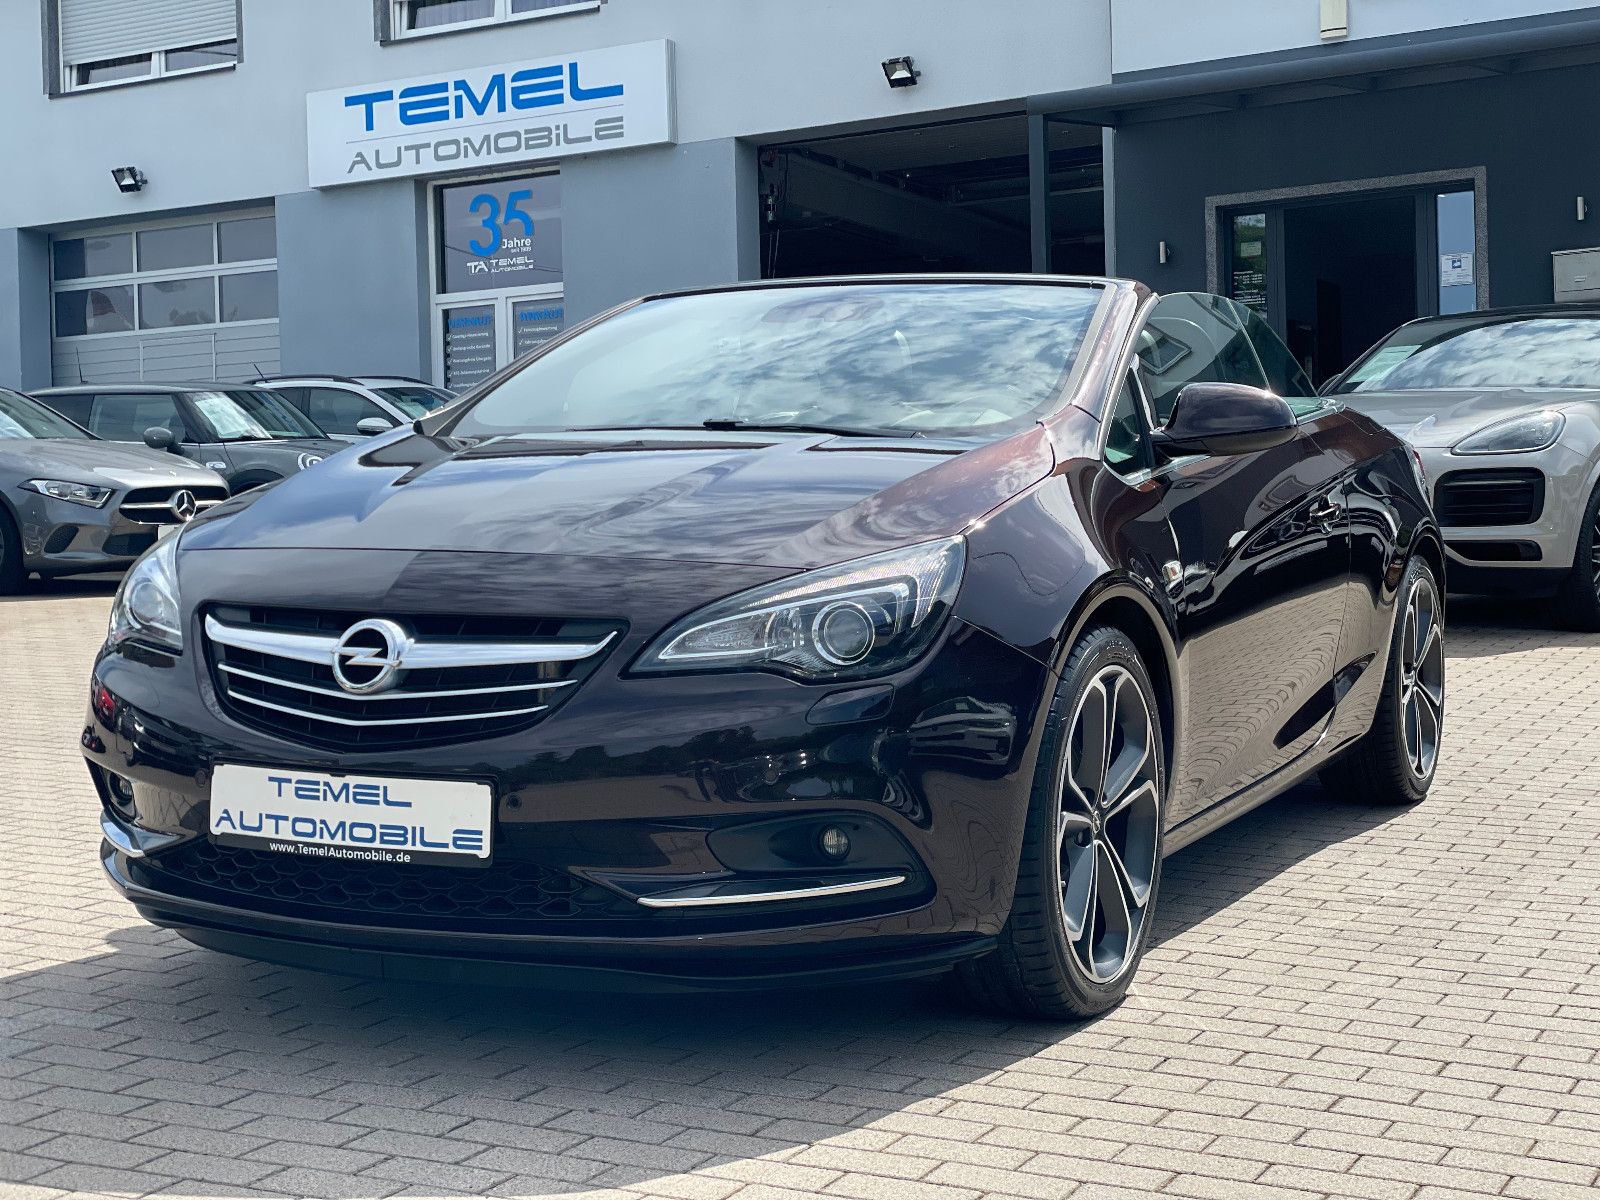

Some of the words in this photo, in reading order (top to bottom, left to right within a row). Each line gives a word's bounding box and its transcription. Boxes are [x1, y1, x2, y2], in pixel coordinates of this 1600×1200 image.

[344, 61, 624, 132] TEMEL
[469, 189, 535, 257] 35
[501, 237, 532, 249] Jahre
[466, 261, 489, 274] TA
[489, 256, 534, 266] TEMEL
[268, 776, 412, 808] TEMEL
[215, 808, 483, 851] AUTOMOBILE
[269, 842, 411, 863] www.TemelAutomobile.de
